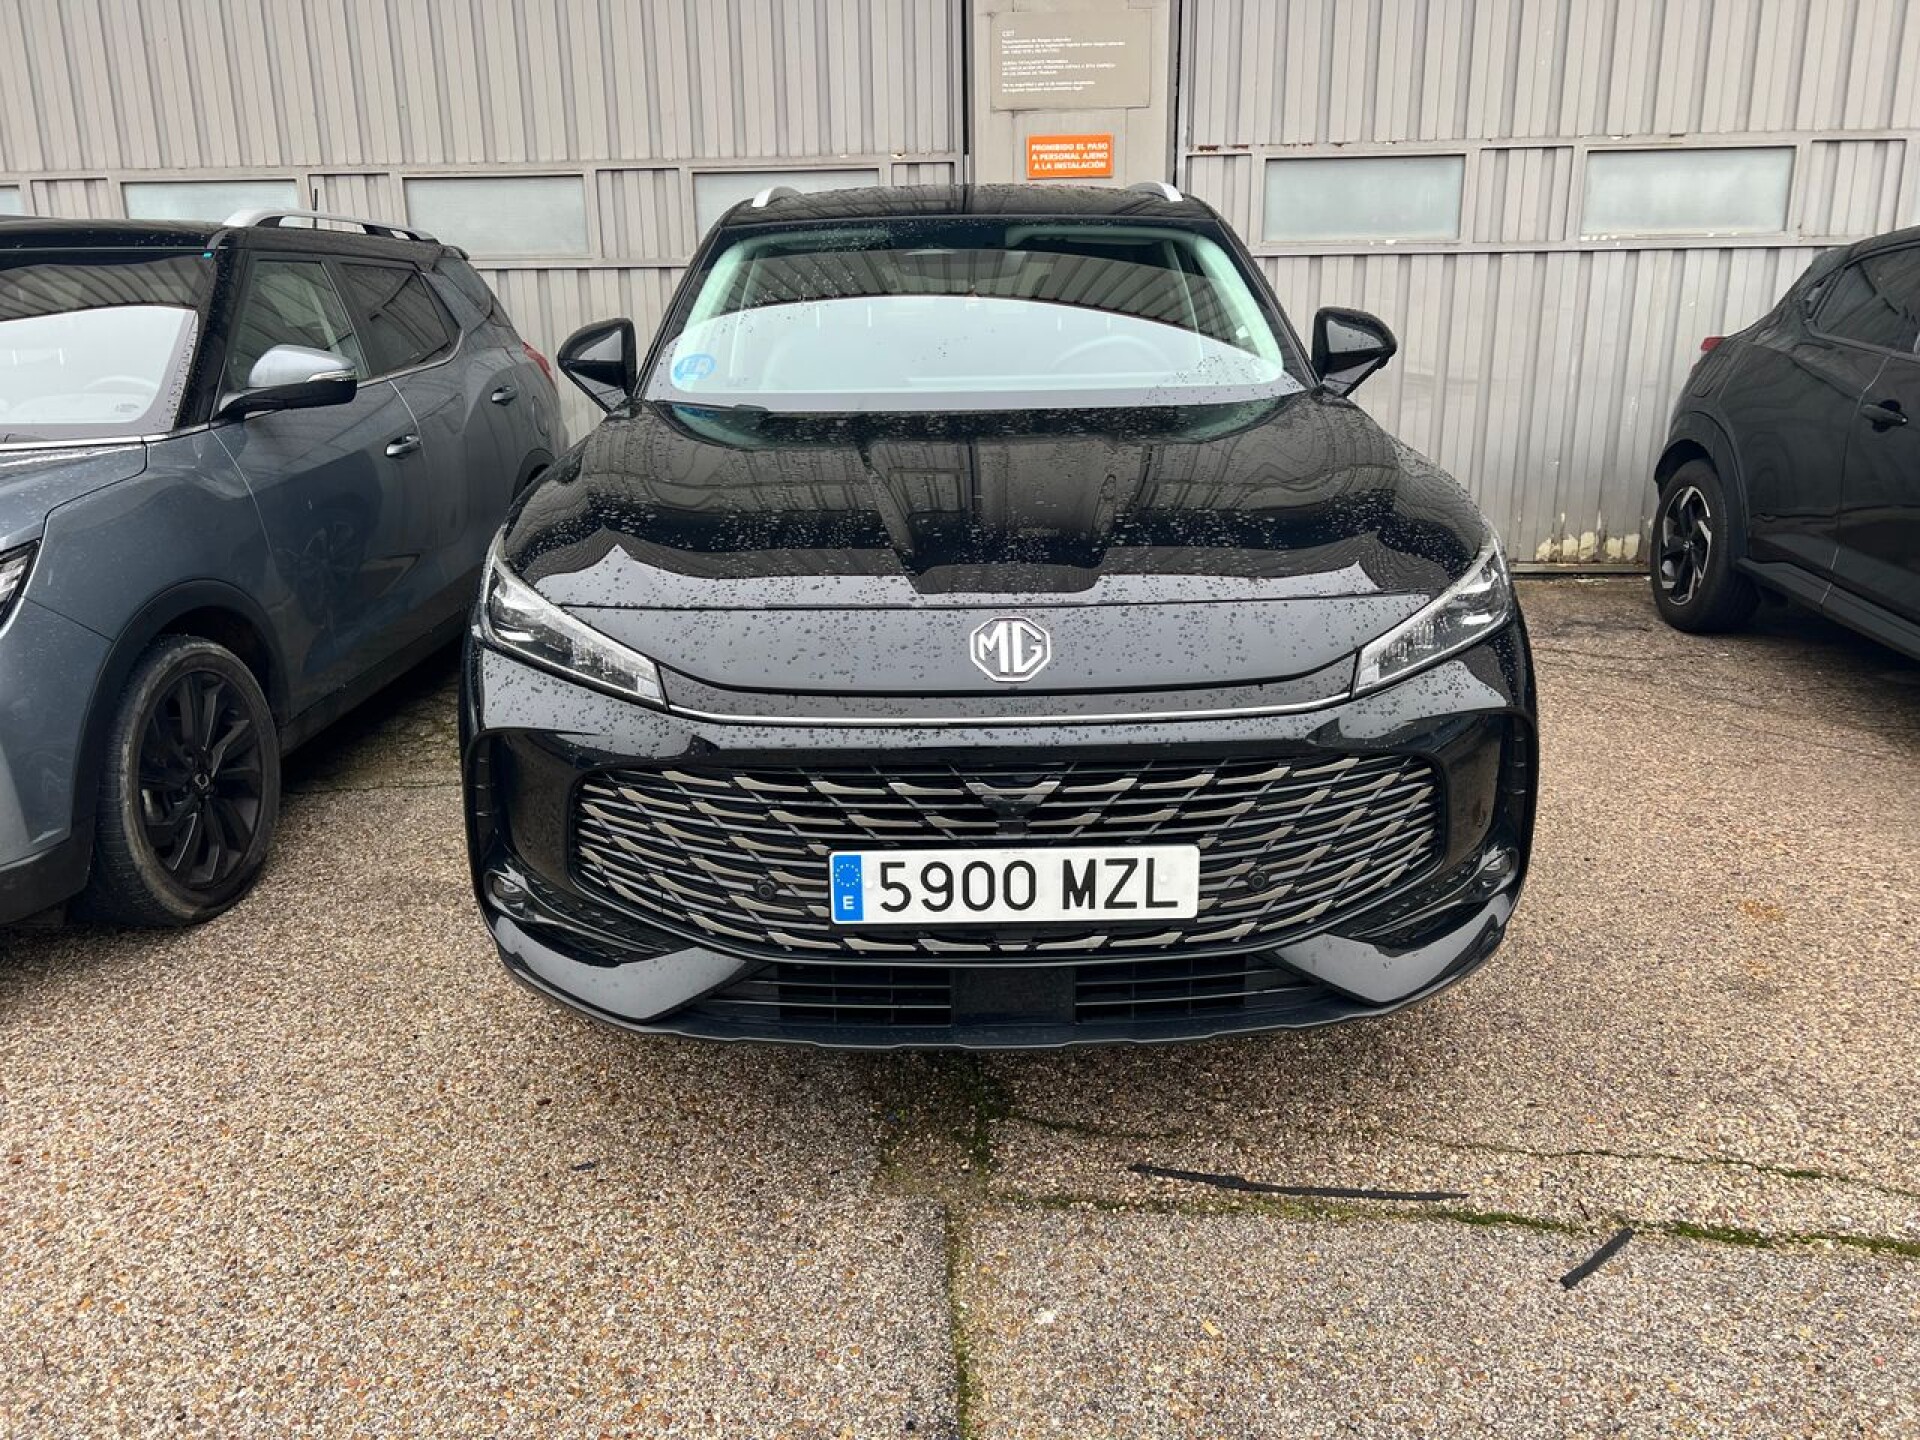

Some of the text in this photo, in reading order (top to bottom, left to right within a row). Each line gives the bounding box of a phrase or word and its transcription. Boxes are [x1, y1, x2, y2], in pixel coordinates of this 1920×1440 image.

[1031, 142, 1108, 151] PROHIBIDO EL PASO
[1039, 152, 1081, 160] PERSONAL
[1082, 151, 1108, 160] AJENO
[1033, 160, 1107, 169] A LA INSTALACIÓN
[977, 620, 1043, 673] MG
[879, 857, 1179, 912] 5900 MZL
[843, 895, 854, 910] E
